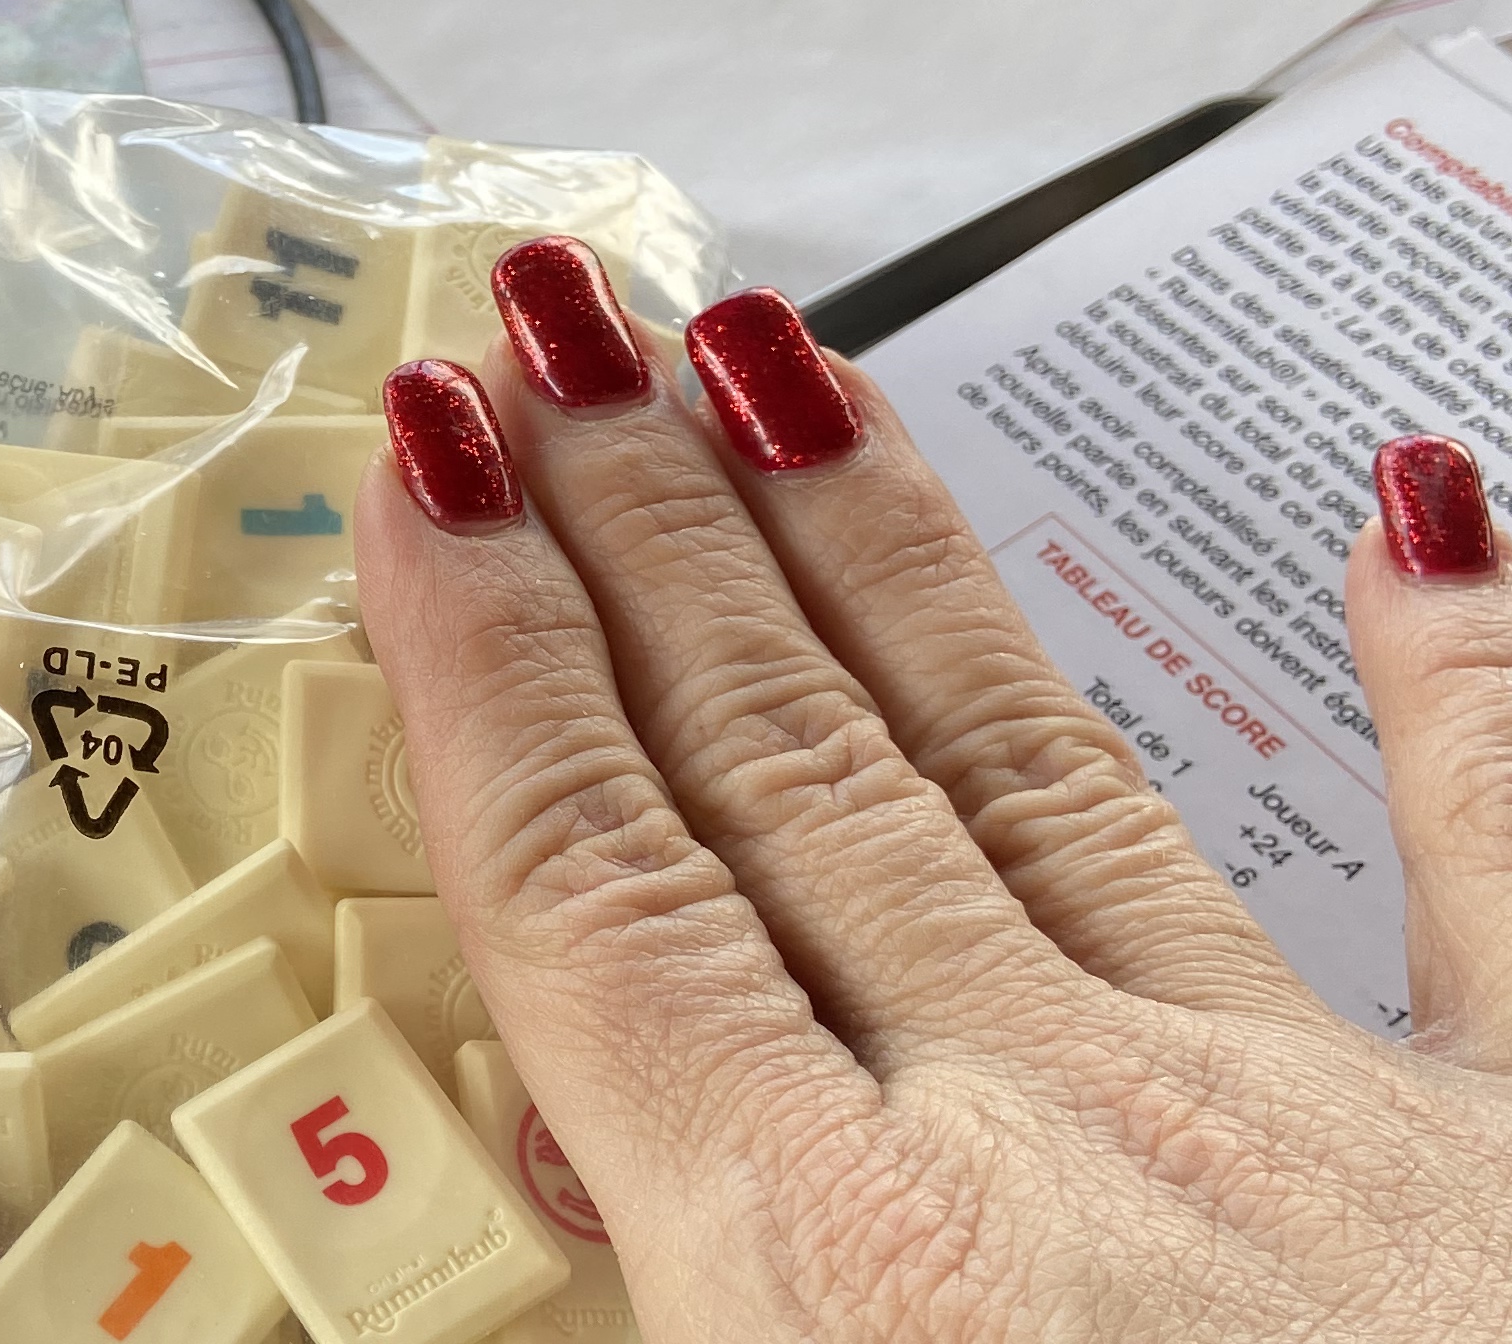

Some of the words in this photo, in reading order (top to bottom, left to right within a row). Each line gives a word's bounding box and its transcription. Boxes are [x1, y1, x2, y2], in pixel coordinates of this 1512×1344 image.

[1230, 292, 1277, 328] des
[1217, 365, 1262, 396] sur
[1256, 395, 1305, 433] son
[986, 364, 1074, 435] nouvelle
[1065, 435, 1137, 489] partie
[1136, 489, 1170, 517] en
[1168, 516, 1254, 584] suivant
[1248, 579, 1291, 616] les
[1014, 345, 1080, 399] Après
[1078, 397, 1136, 440] avoir
[1271, 551, 1312, 588] les
[1135, 381, 1184, 420] leur
[1180, 421, 1246, 473] score
[1244, 473, 1280, 501] de
[1279, 500, 1314, 528] ce
[957, 382, 989, 409] de
[986, 404, 1042, 454] leurs
[1111, 510, 1151, 545] les
[1141, 541, 1235, 617] joueurs
[1235, 618, 1327, 692] doivent
[42, 647, 170, 693] PE-LD
[1037, 540, 1152, 641] TABLEAU
[1145, 636, 1190, 677] DE
[1186, 673, 1287, 761] SCORE
[80, 730, 124, 766] 04
[1084, 676, 1142, 730] Total
[1135, 727, 1171, 763] de
[1172, 759, 1194, 779] 1
[1224, 860, 1259, 890] -6
[1239, 823, 1294, 870] +24
[1248, 783, 1342, 858] Joueur
[1332, 859, 1367, 882] A
[290, 1095, 389, 1206] 5
[97, 1240, 193, 1342] 1
[346, 1219, 512, 1336] Rummikub
